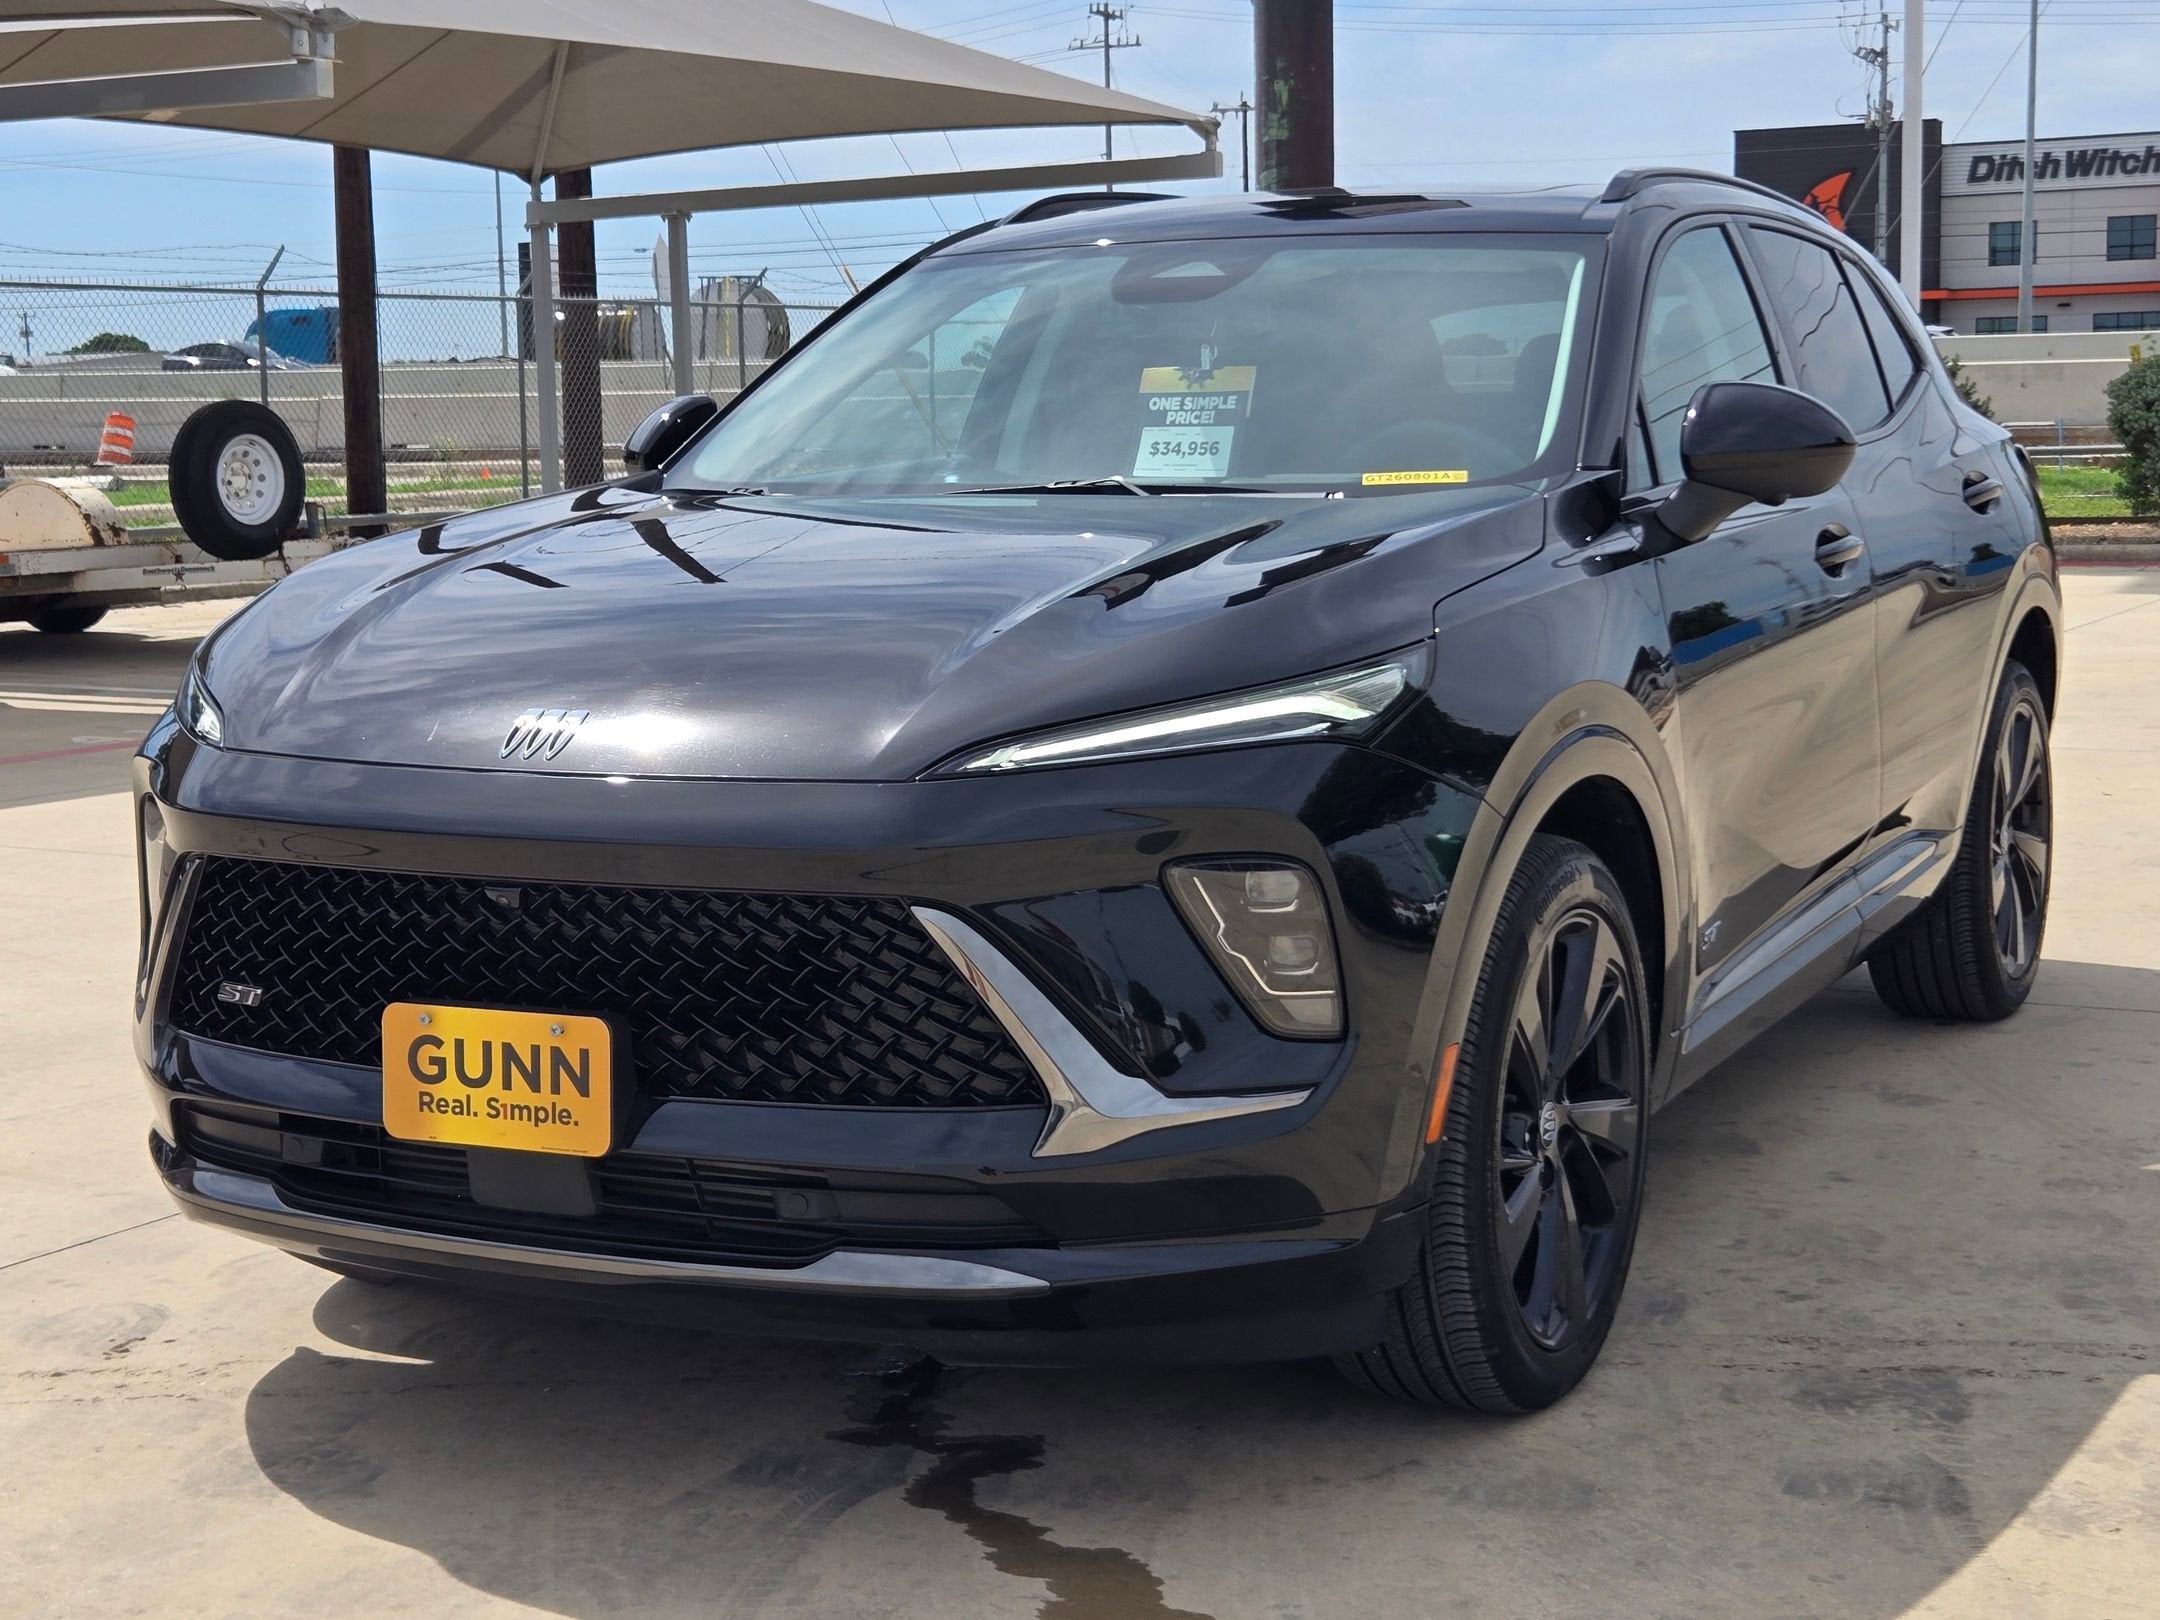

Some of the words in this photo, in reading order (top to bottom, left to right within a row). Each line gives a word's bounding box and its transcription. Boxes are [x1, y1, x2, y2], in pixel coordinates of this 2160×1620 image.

[2064, 146, 2160, 178] Witch
[1149, 397, 1181, 411] ONE
[1183, 395, 1237, 410] SIMPLE
[1165, 411, 1216, 424] PRICE!
[1149, 440, 1220, 459] $34,956
[1364, 472, 1451, 483] GT260801A
[217, 981, 262, 1007] ST
[407, 1034, 590, 1098] GUNN
[418, 1091, 478, 1117] Real.
